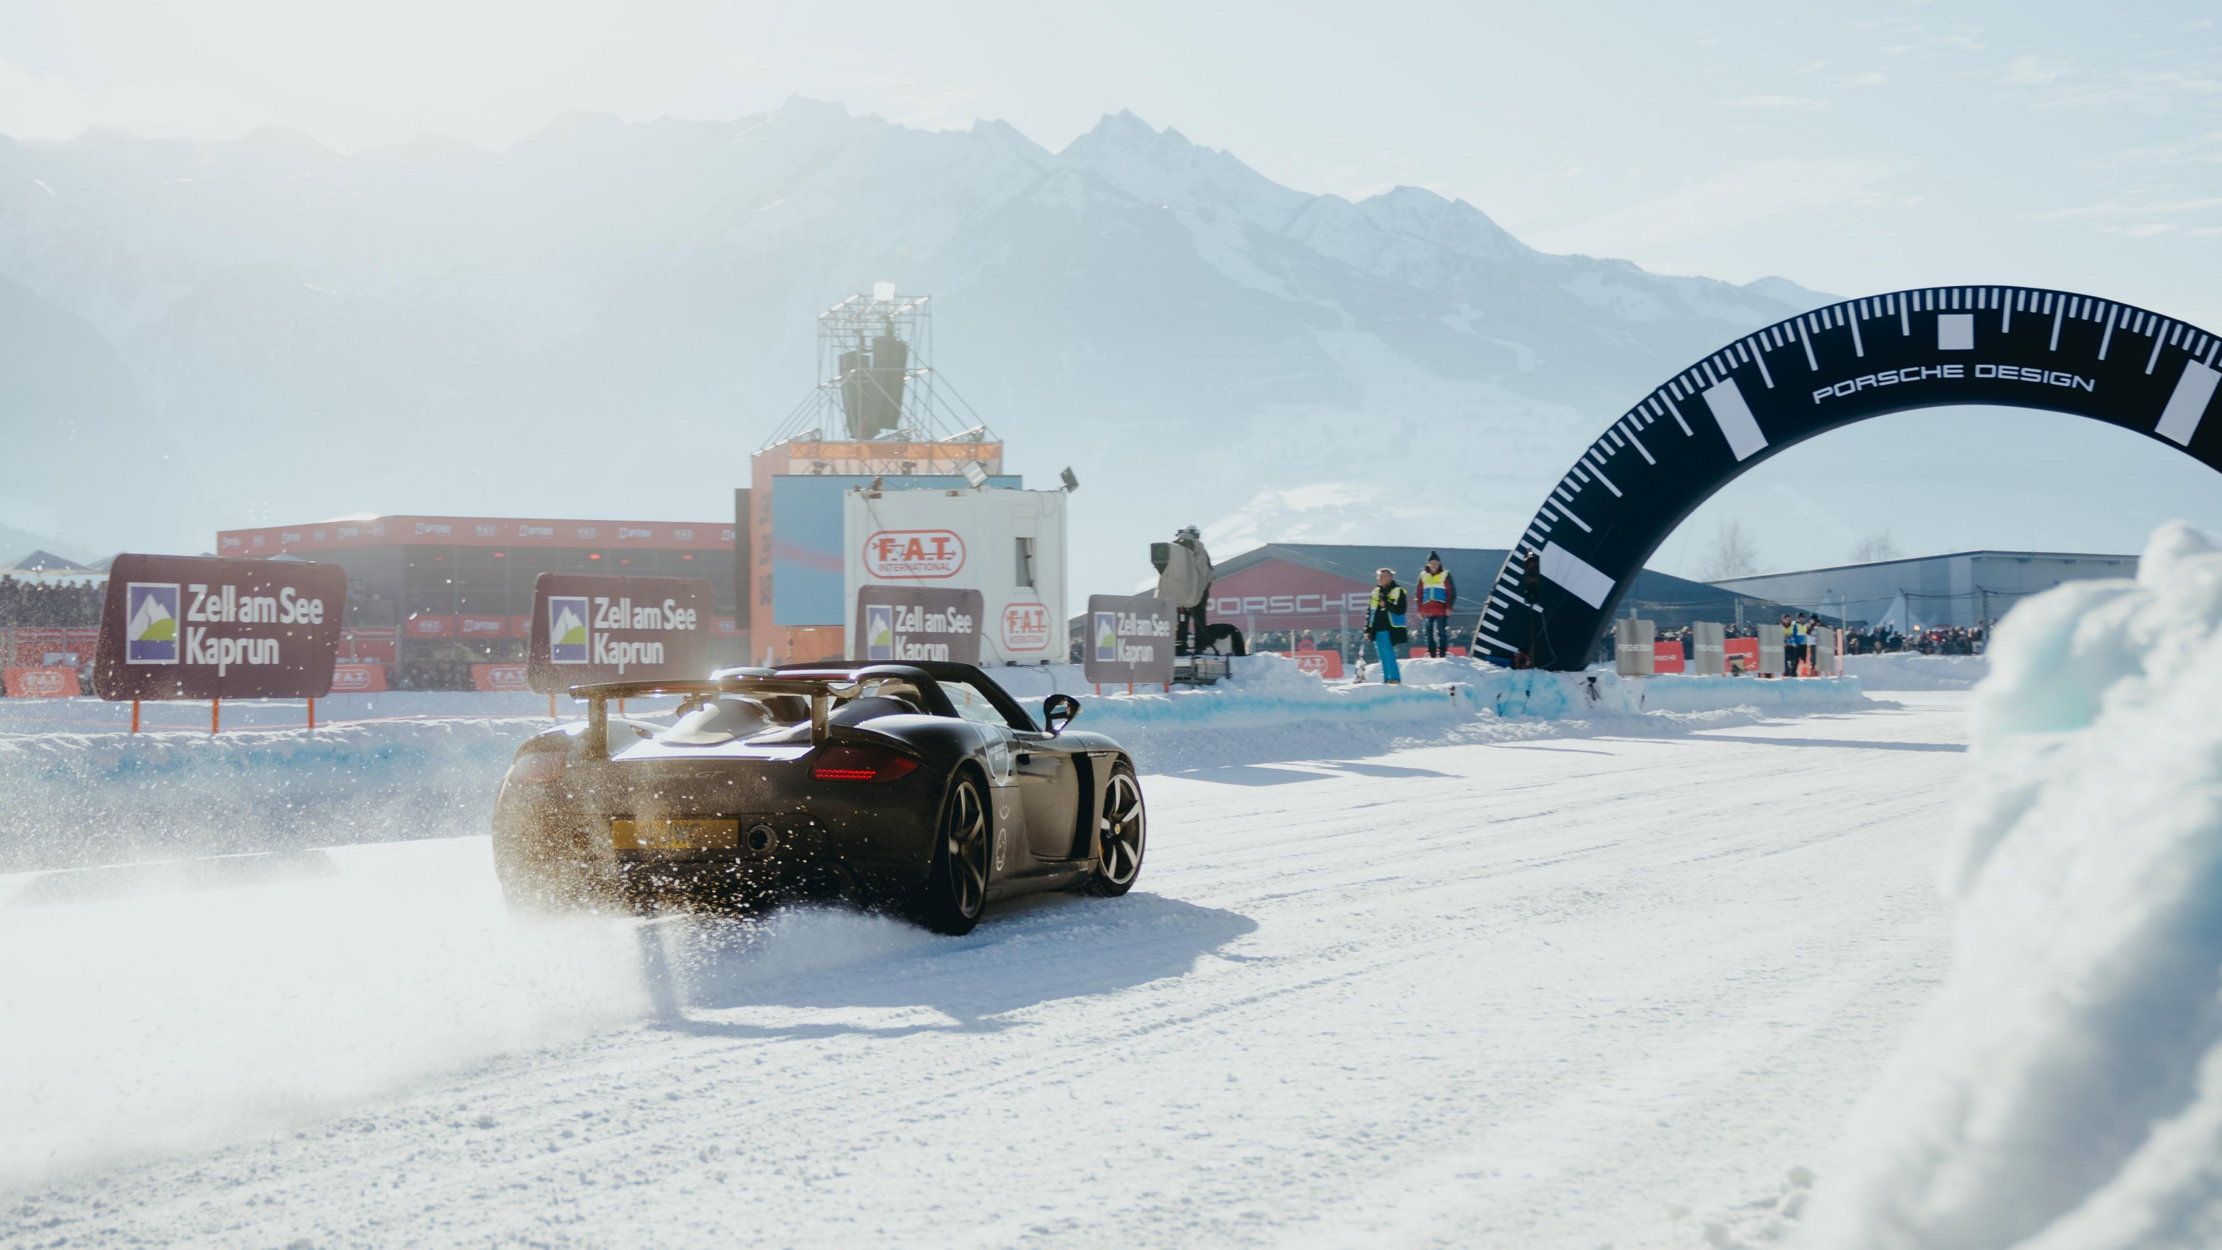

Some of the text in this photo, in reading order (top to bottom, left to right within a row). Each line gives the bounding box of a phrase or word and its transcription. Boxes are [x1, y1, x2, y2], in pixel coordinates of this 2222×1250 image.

[1812, 364, 2095, 404] PORSCHE DESIGN
[187, 584, 324, 625] Zell am See
[594, 597, 697, 630] Zell am See
[895, 605, 972, 633] Zell am See
[1117, 612, 1137, 636] Zell
[1152, 613, 1170, 637] See
[186, 626, 280, 677] Kaprun
[594, 632, 664, 675] Kaprun
[1117, 638, 1154, 670] Kaprun
